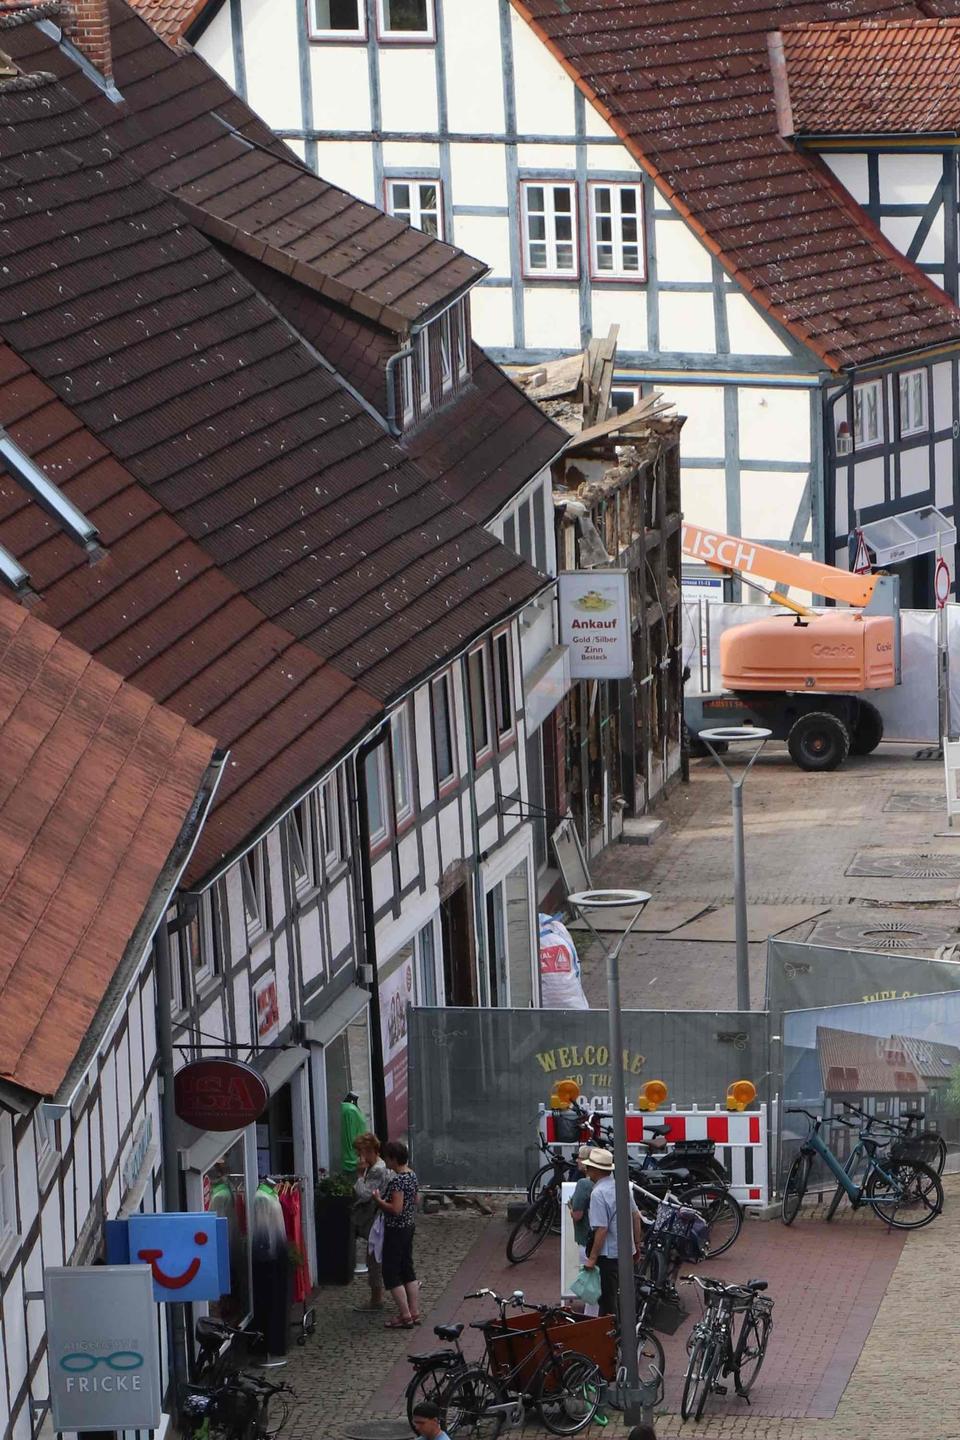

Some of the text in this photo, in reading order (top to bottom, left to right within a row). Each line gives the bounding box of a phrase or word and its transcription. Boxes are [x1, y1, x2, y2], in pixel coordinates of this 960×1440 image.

[682, 527, 756, 571] LISCH
[571, 618, 617, 629] Ankauf
[584, 646, 603, 654] Zinn
[811, 643, 856, 657] Genie
[66, 1375, 142, 1393] FRICKE
